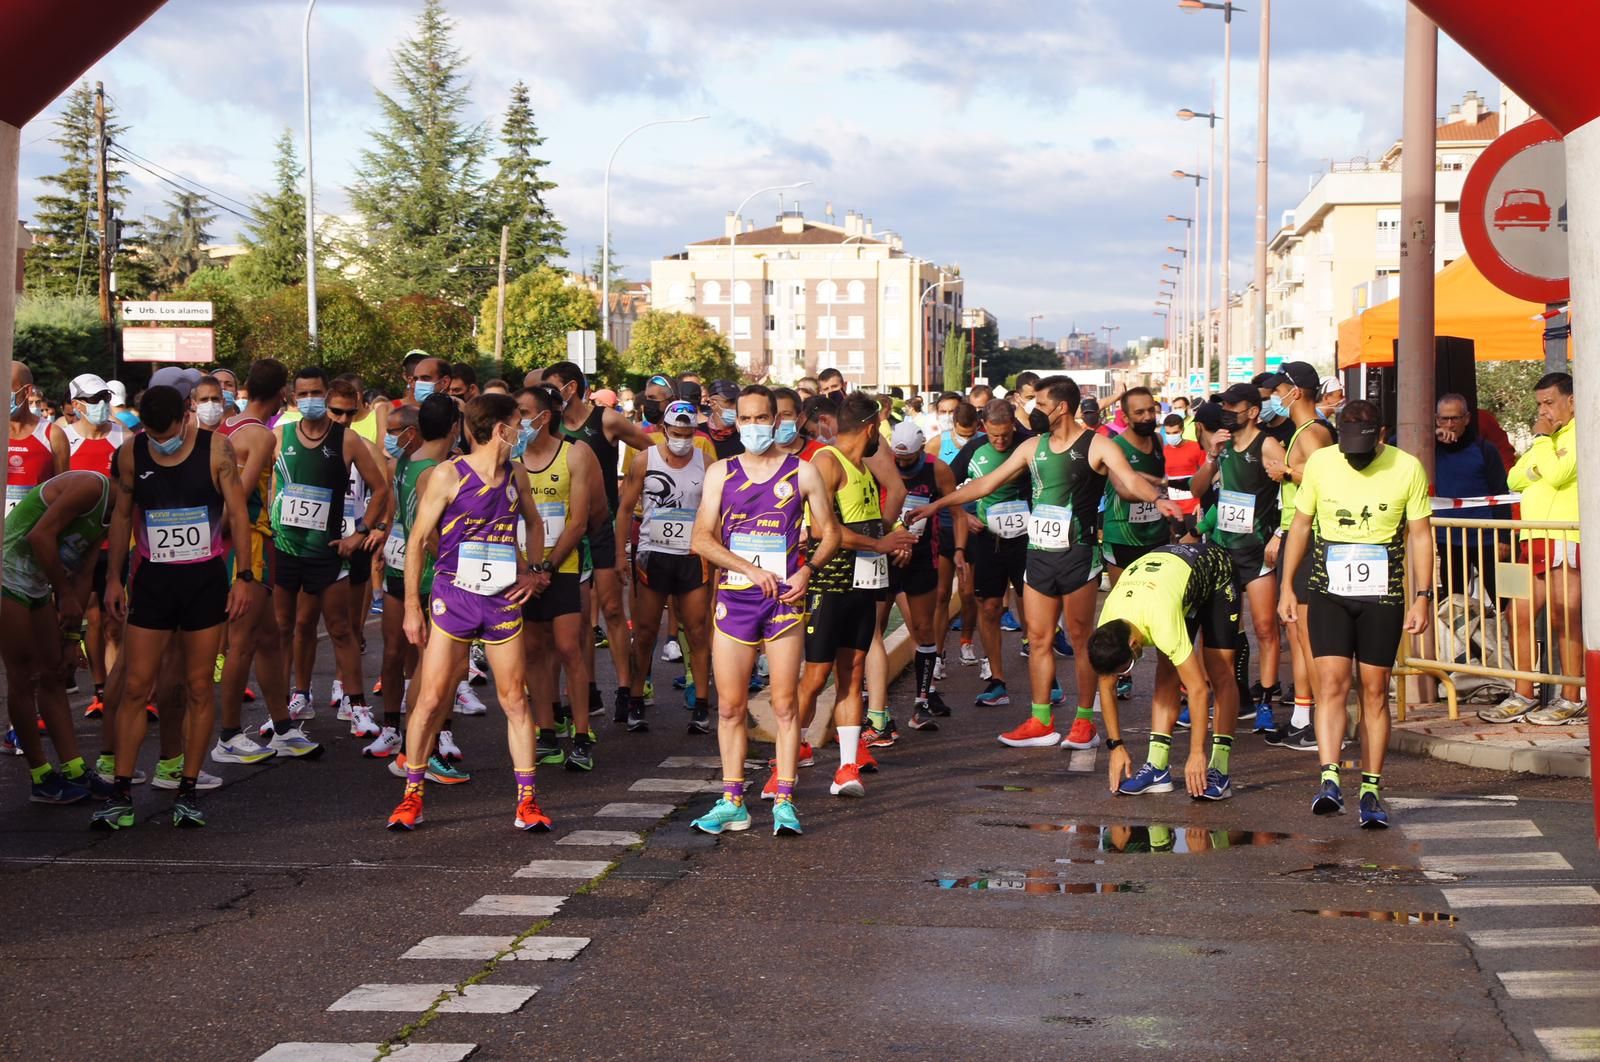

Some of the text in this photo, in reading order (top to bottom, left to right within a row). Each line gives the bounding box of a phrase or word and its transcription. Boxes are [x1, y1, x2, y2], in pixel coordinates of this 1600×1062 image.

[290, 499, 322, 518] 157
[1221, 505, 1246, 523] 134
[662, 522, 684, 538] 82
[757, 519, 780, 528] PRIM
[995, 513, 1024, 530] 143
[1034, 519, 1061, 537] 149
[156, 526, 200, 549] 250
[752, 554, 762, 569] 4
[872, 558, 886, 577] 18
[480, 562, 493, 582] 5
[1345, 563, 1370, 582] 19
